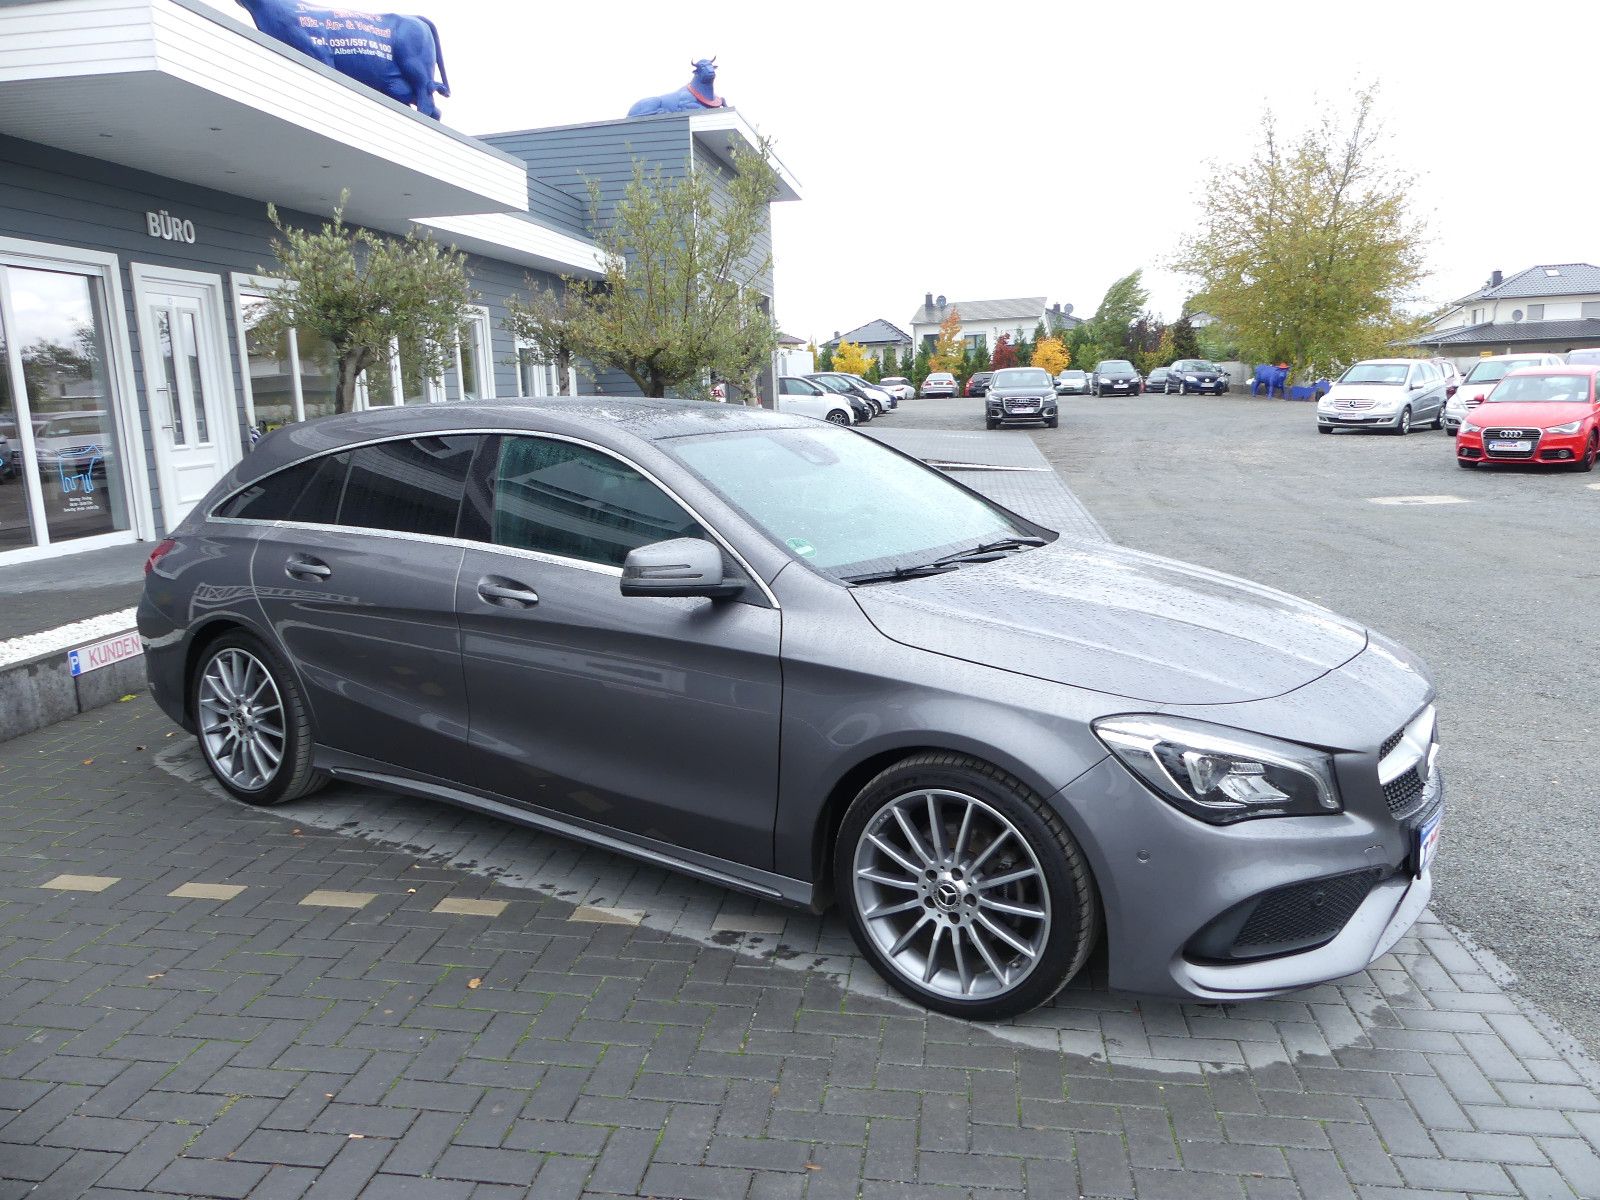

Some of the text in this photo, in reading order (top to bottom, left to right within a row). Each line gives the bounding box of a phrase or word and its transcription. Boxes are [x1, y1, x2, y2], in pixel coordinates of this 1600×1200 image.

[311, 37, 328, 46] Tel.
[330, 38, 367, 47] 0391/597
[378, 43, 392, 53] 100
[146, 209, 195, 244] BÜRO
[71, 637, 140, 671] P KUNDEN
